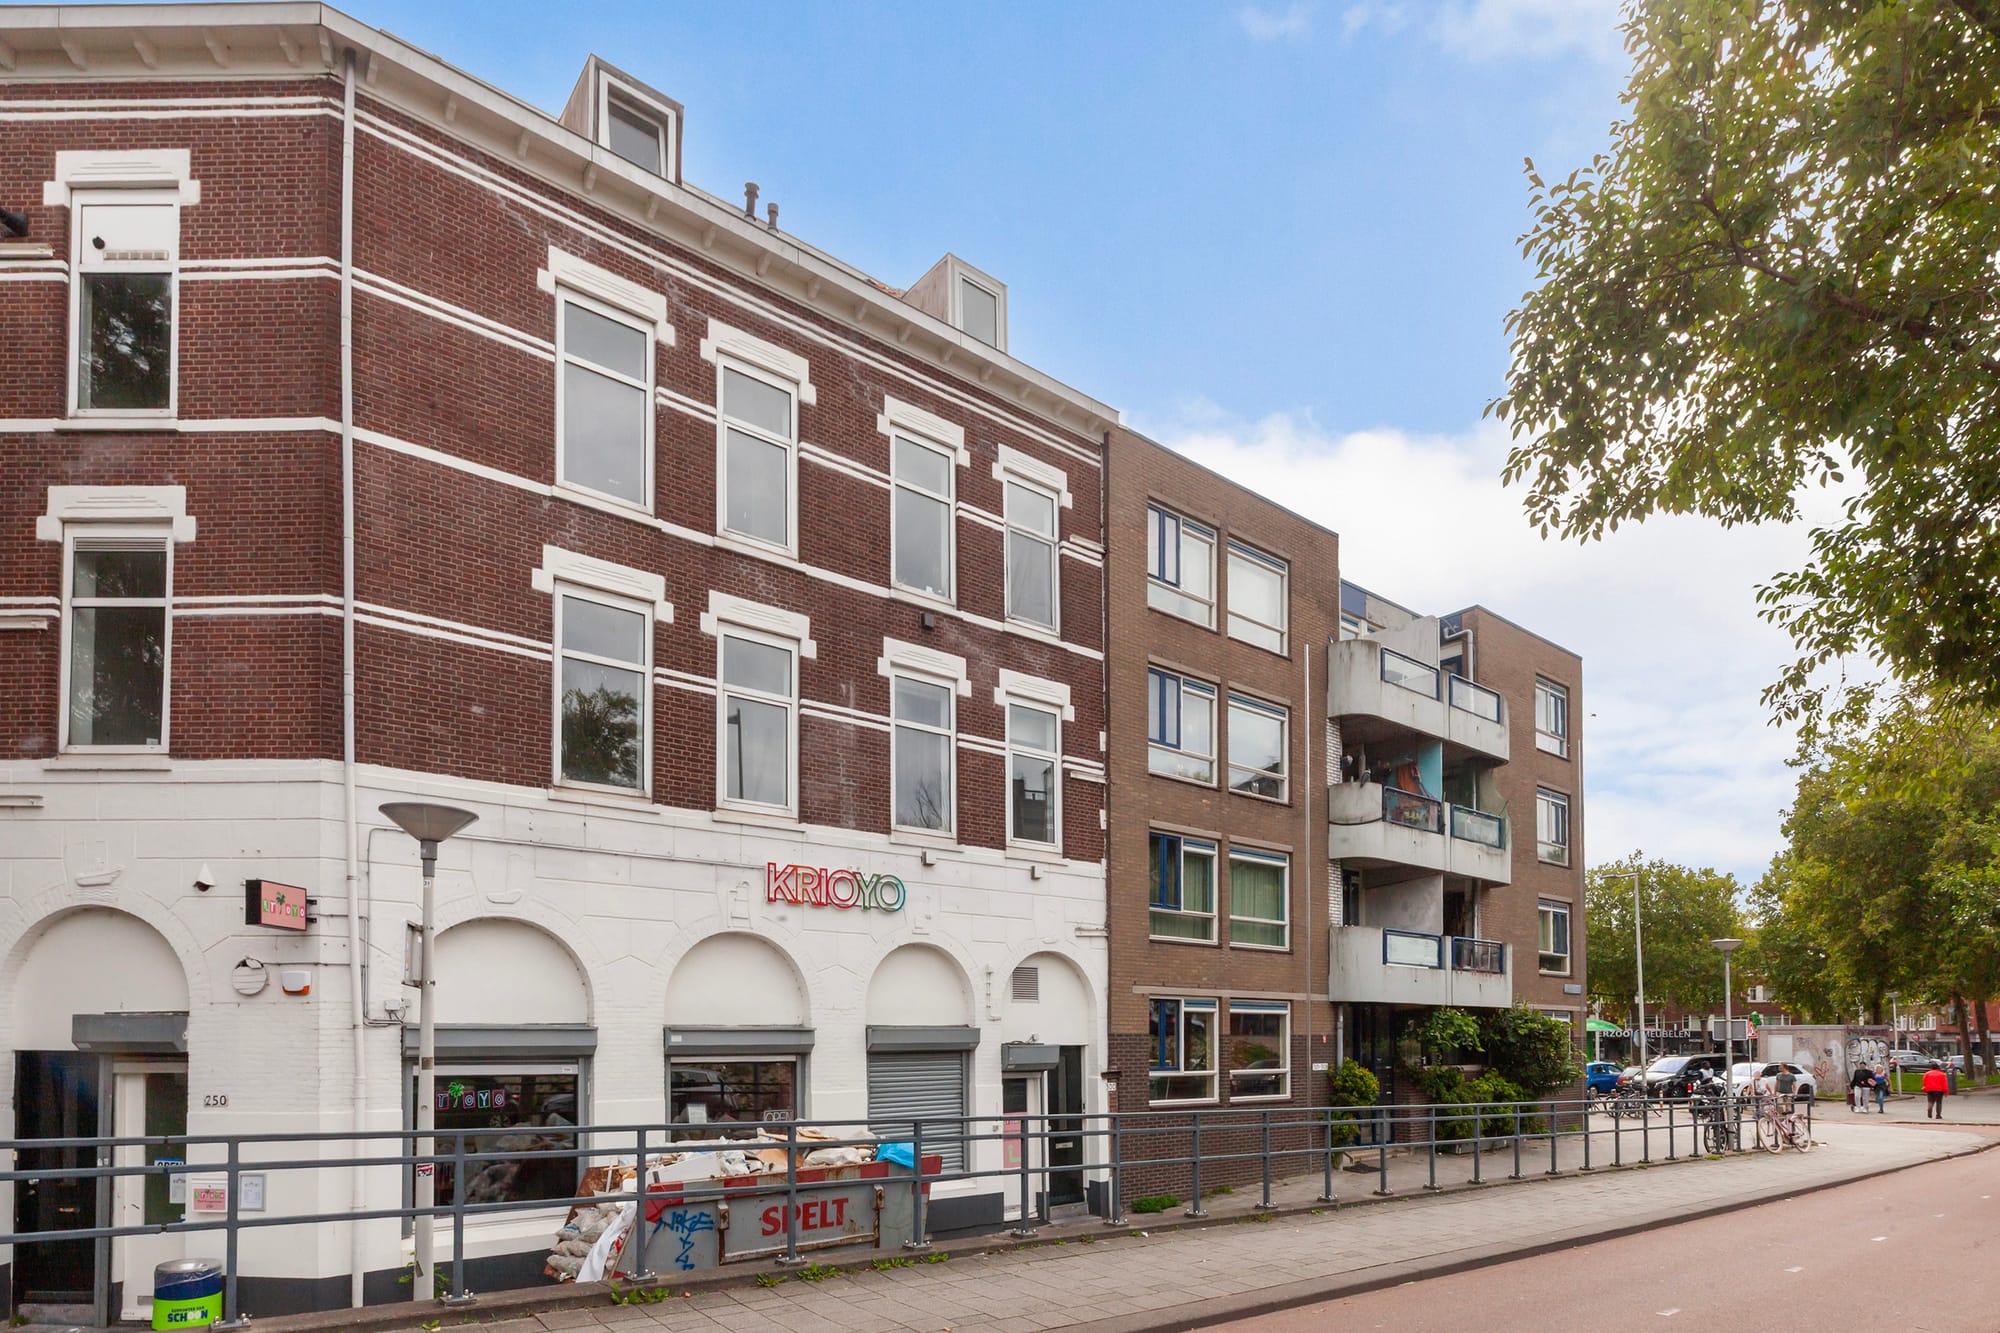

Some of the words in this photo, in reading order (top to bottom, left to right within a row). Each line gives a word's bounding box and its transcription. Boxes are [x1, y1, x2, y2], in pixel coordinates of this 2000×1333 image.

[767, 862, 906, 912] KRIOYO
[203, 1095, 227, 1106] 250
[761, 1197, 849, 1237] SPELT
[167, 1310, 209, 1322] SCHOON
